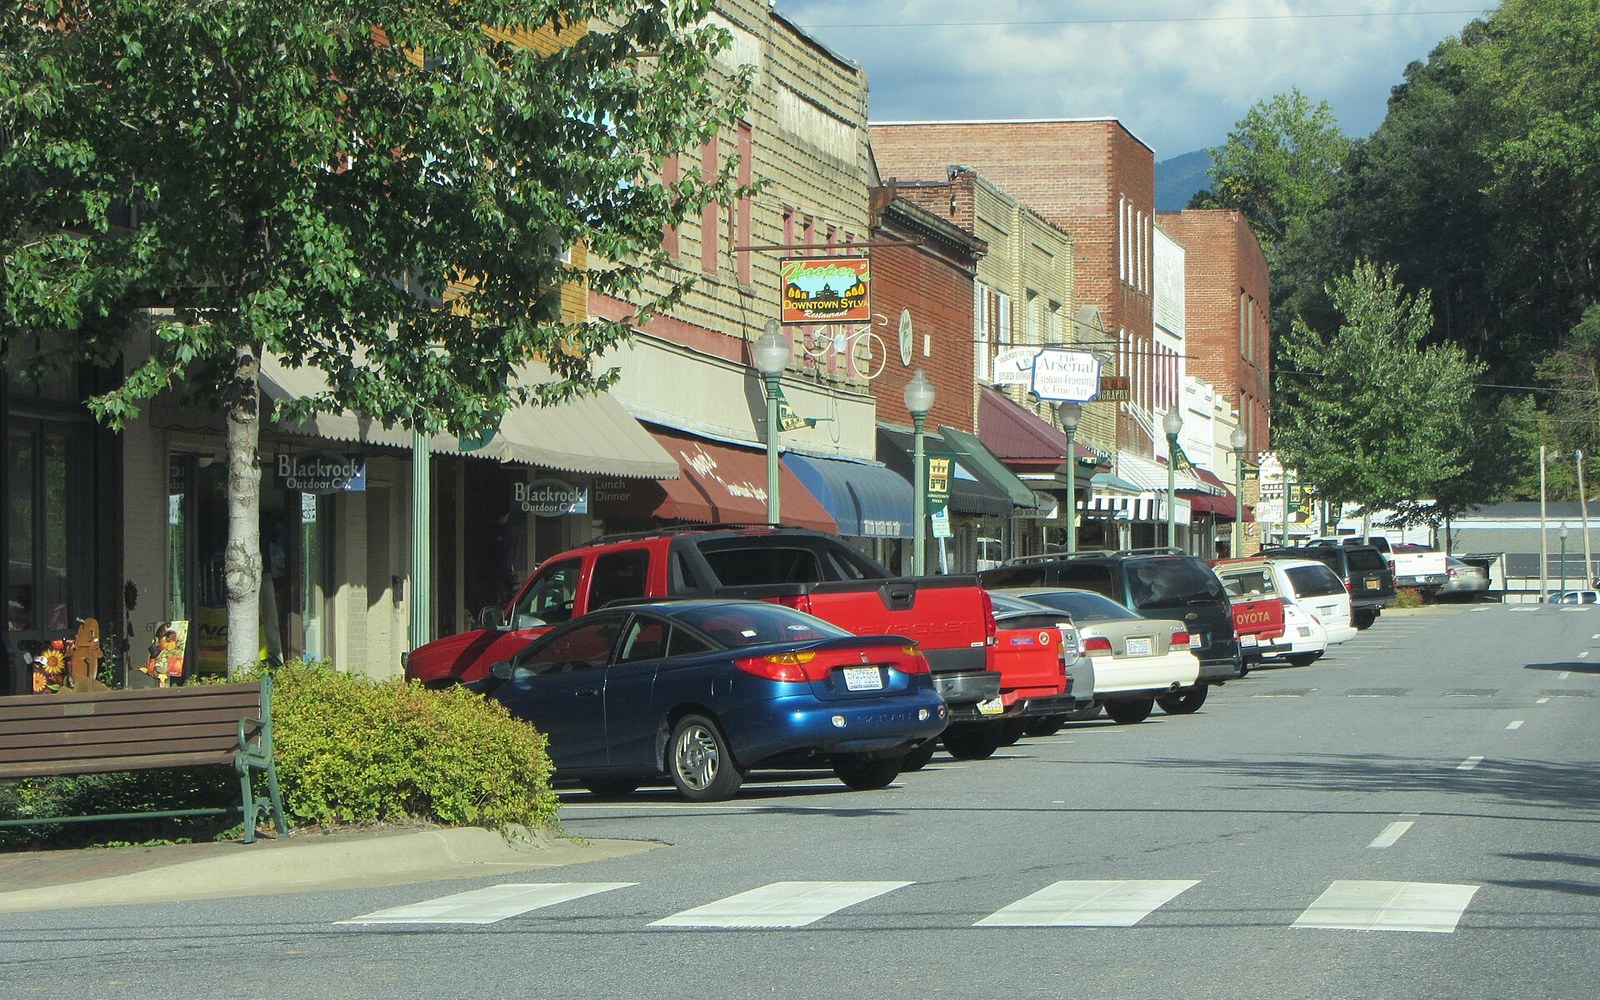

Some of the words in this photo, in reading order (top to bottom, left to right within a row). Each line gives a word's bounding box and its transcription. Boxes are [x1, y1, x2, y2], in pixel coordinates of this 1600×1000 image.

[780, 262, 871, 283] Hooper's
[783, 300, 839, 310] DOWNTOWN
[840, 298, 869, 308] SYLVA
[803, 309, 848, 318] Restaurant
[1038, 357, 1094, 374] Arsenal
[1036, 373, 1064, 384] Custom
[1064, 375, 1096, 387] Framing
[1041, 384, 1051, 393] &
[1052, 386, 1069, 395] Fine
[1073, 386, 1088, 395] Art
[277, 454, 361, 477] Blackrock
[286, 477, 330, 489] Outdoor
[595, 479, 626, 490] Lunch
[514, 482, 584, 502] Blackrock
[595, 491, 632, 501] Dinner
[521, 501, 558, 512] Outdoor
[1236, 611, 1271, 625] OYOTA
[851, 619, 977, 636] EVROLET
